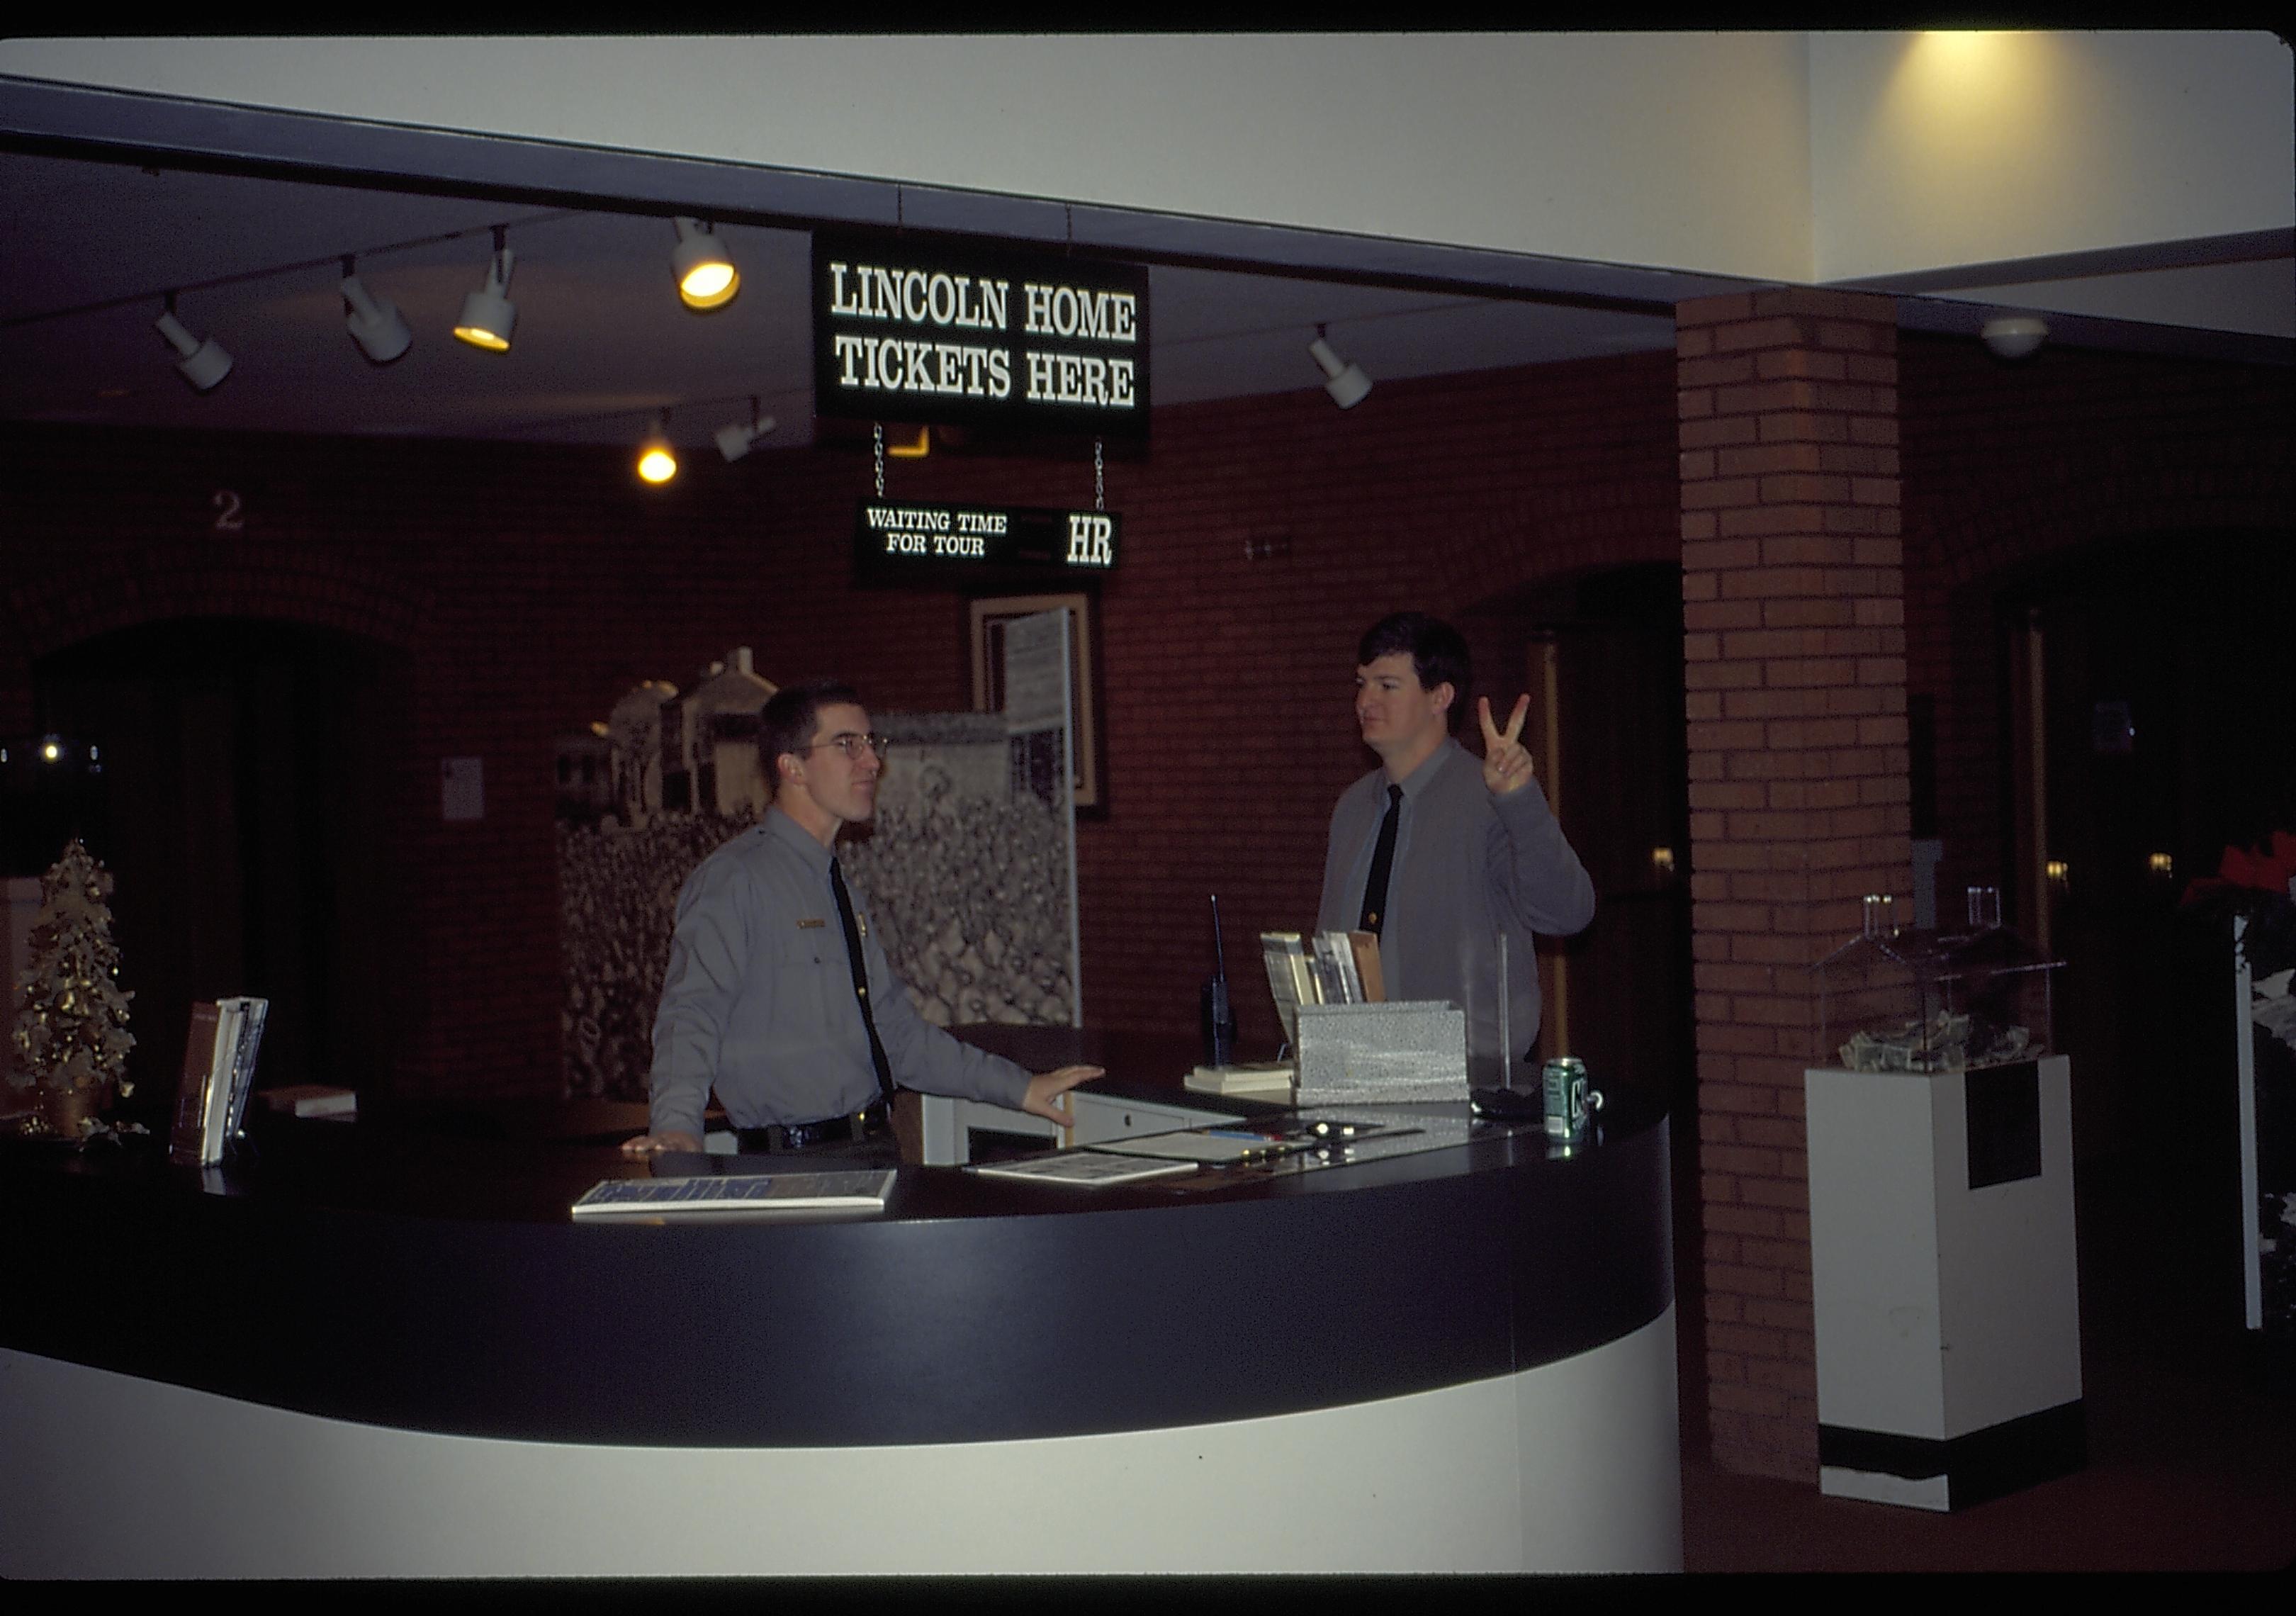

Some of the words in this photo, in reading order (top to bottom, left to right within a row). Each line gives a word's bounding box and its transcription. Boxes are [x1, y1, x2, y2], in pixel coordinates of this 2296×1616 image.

[830, 263, 1009, 330] LINCOLN
[1024, 284, 1137, 342] HOME
[835, 335, 1011, 398] TICKETS
[1026, 352, 1135, 408] HERE
[213, 490, 244, 530] 2
[867, 507, 951, 532] WAITING
[957, 513, 1008, 534] TIME
[886, 532, 927, 554] FOR
[933, 535, 986, 556] TOUR
[1067, 515, 1113, 566] HR
